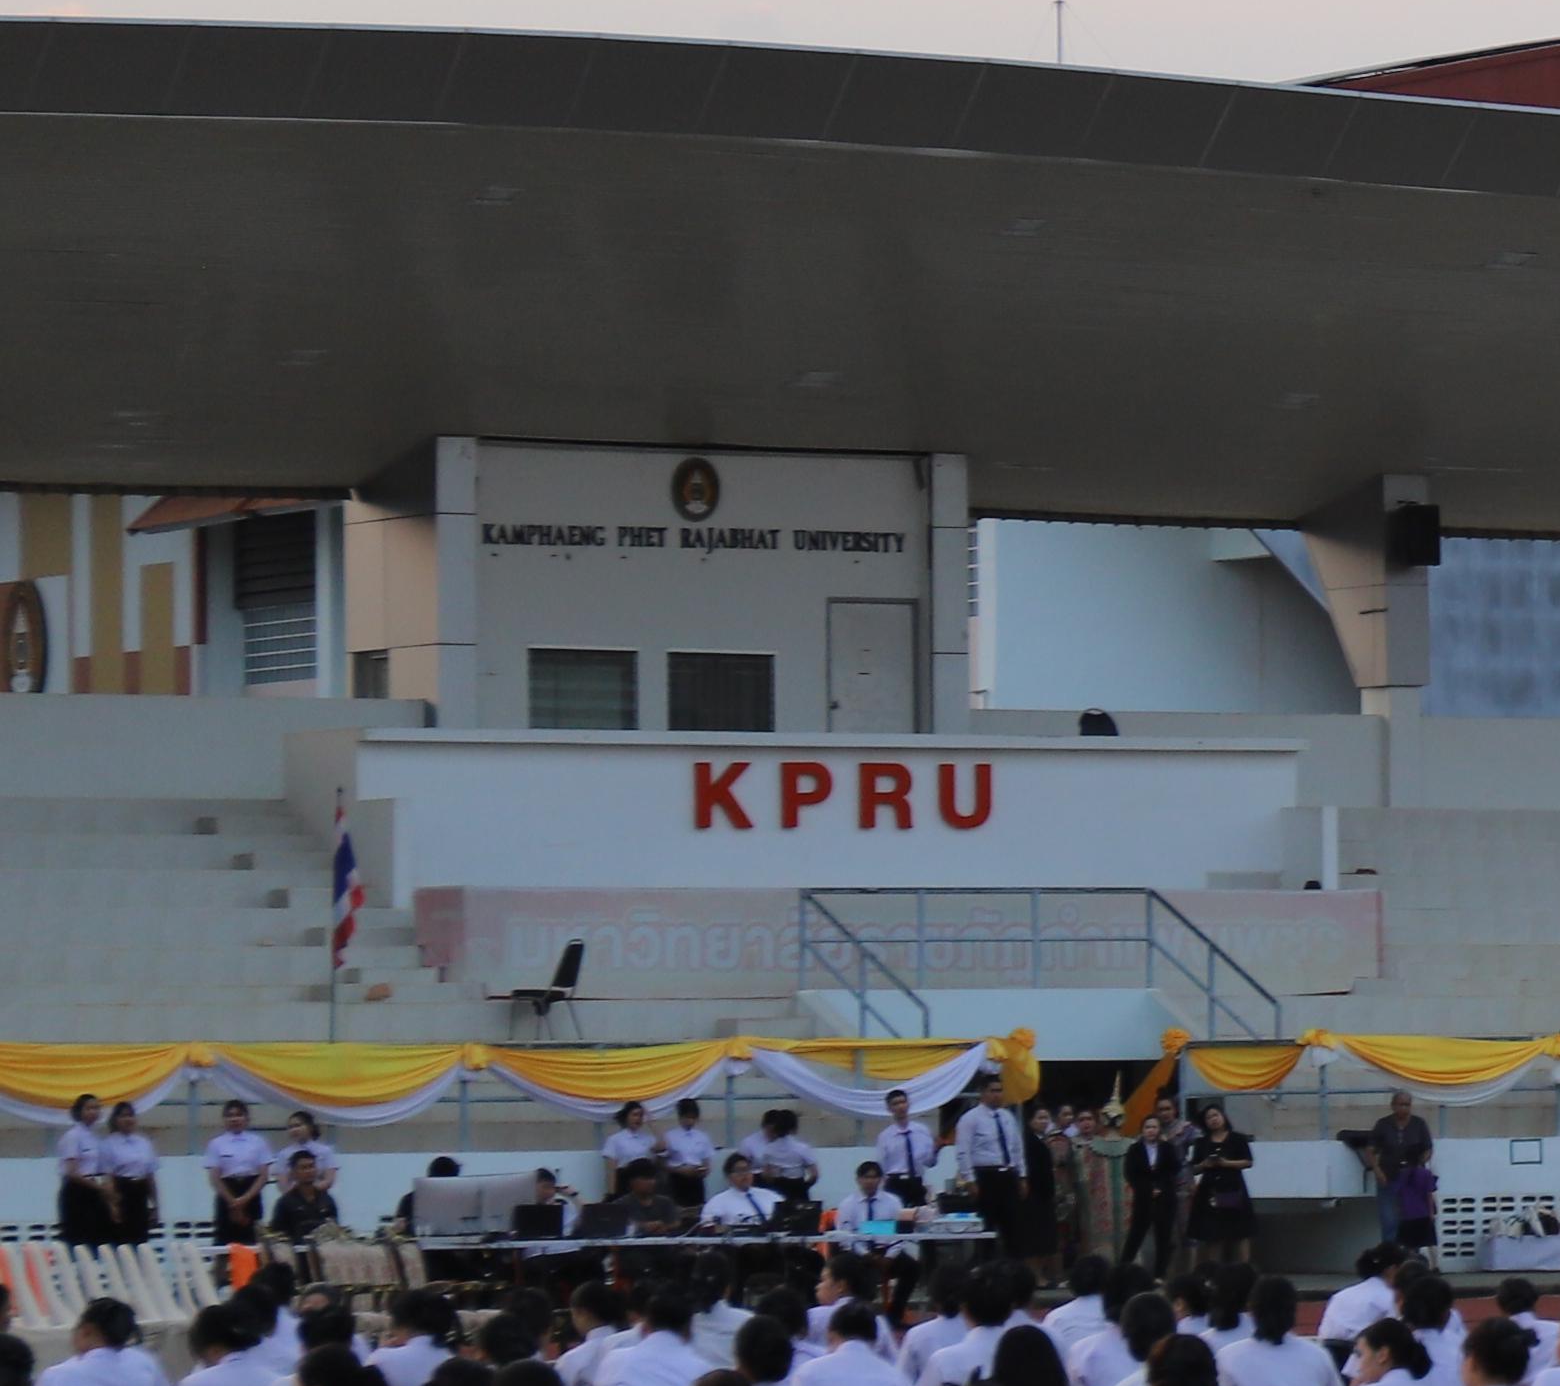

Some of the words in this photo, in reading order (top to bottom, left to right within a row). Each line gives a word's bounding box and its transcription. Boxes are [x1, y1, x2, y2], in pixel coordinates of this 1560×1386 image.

[482, 524, 605, 547] KAMPHAENG
[617, 526, 667, 549] PHET
[680, 527, 781, 554] RAJABHAT
[793, 530, 906, 553] UNIVERSITY
[694, 762, 992, 830] KPRU
